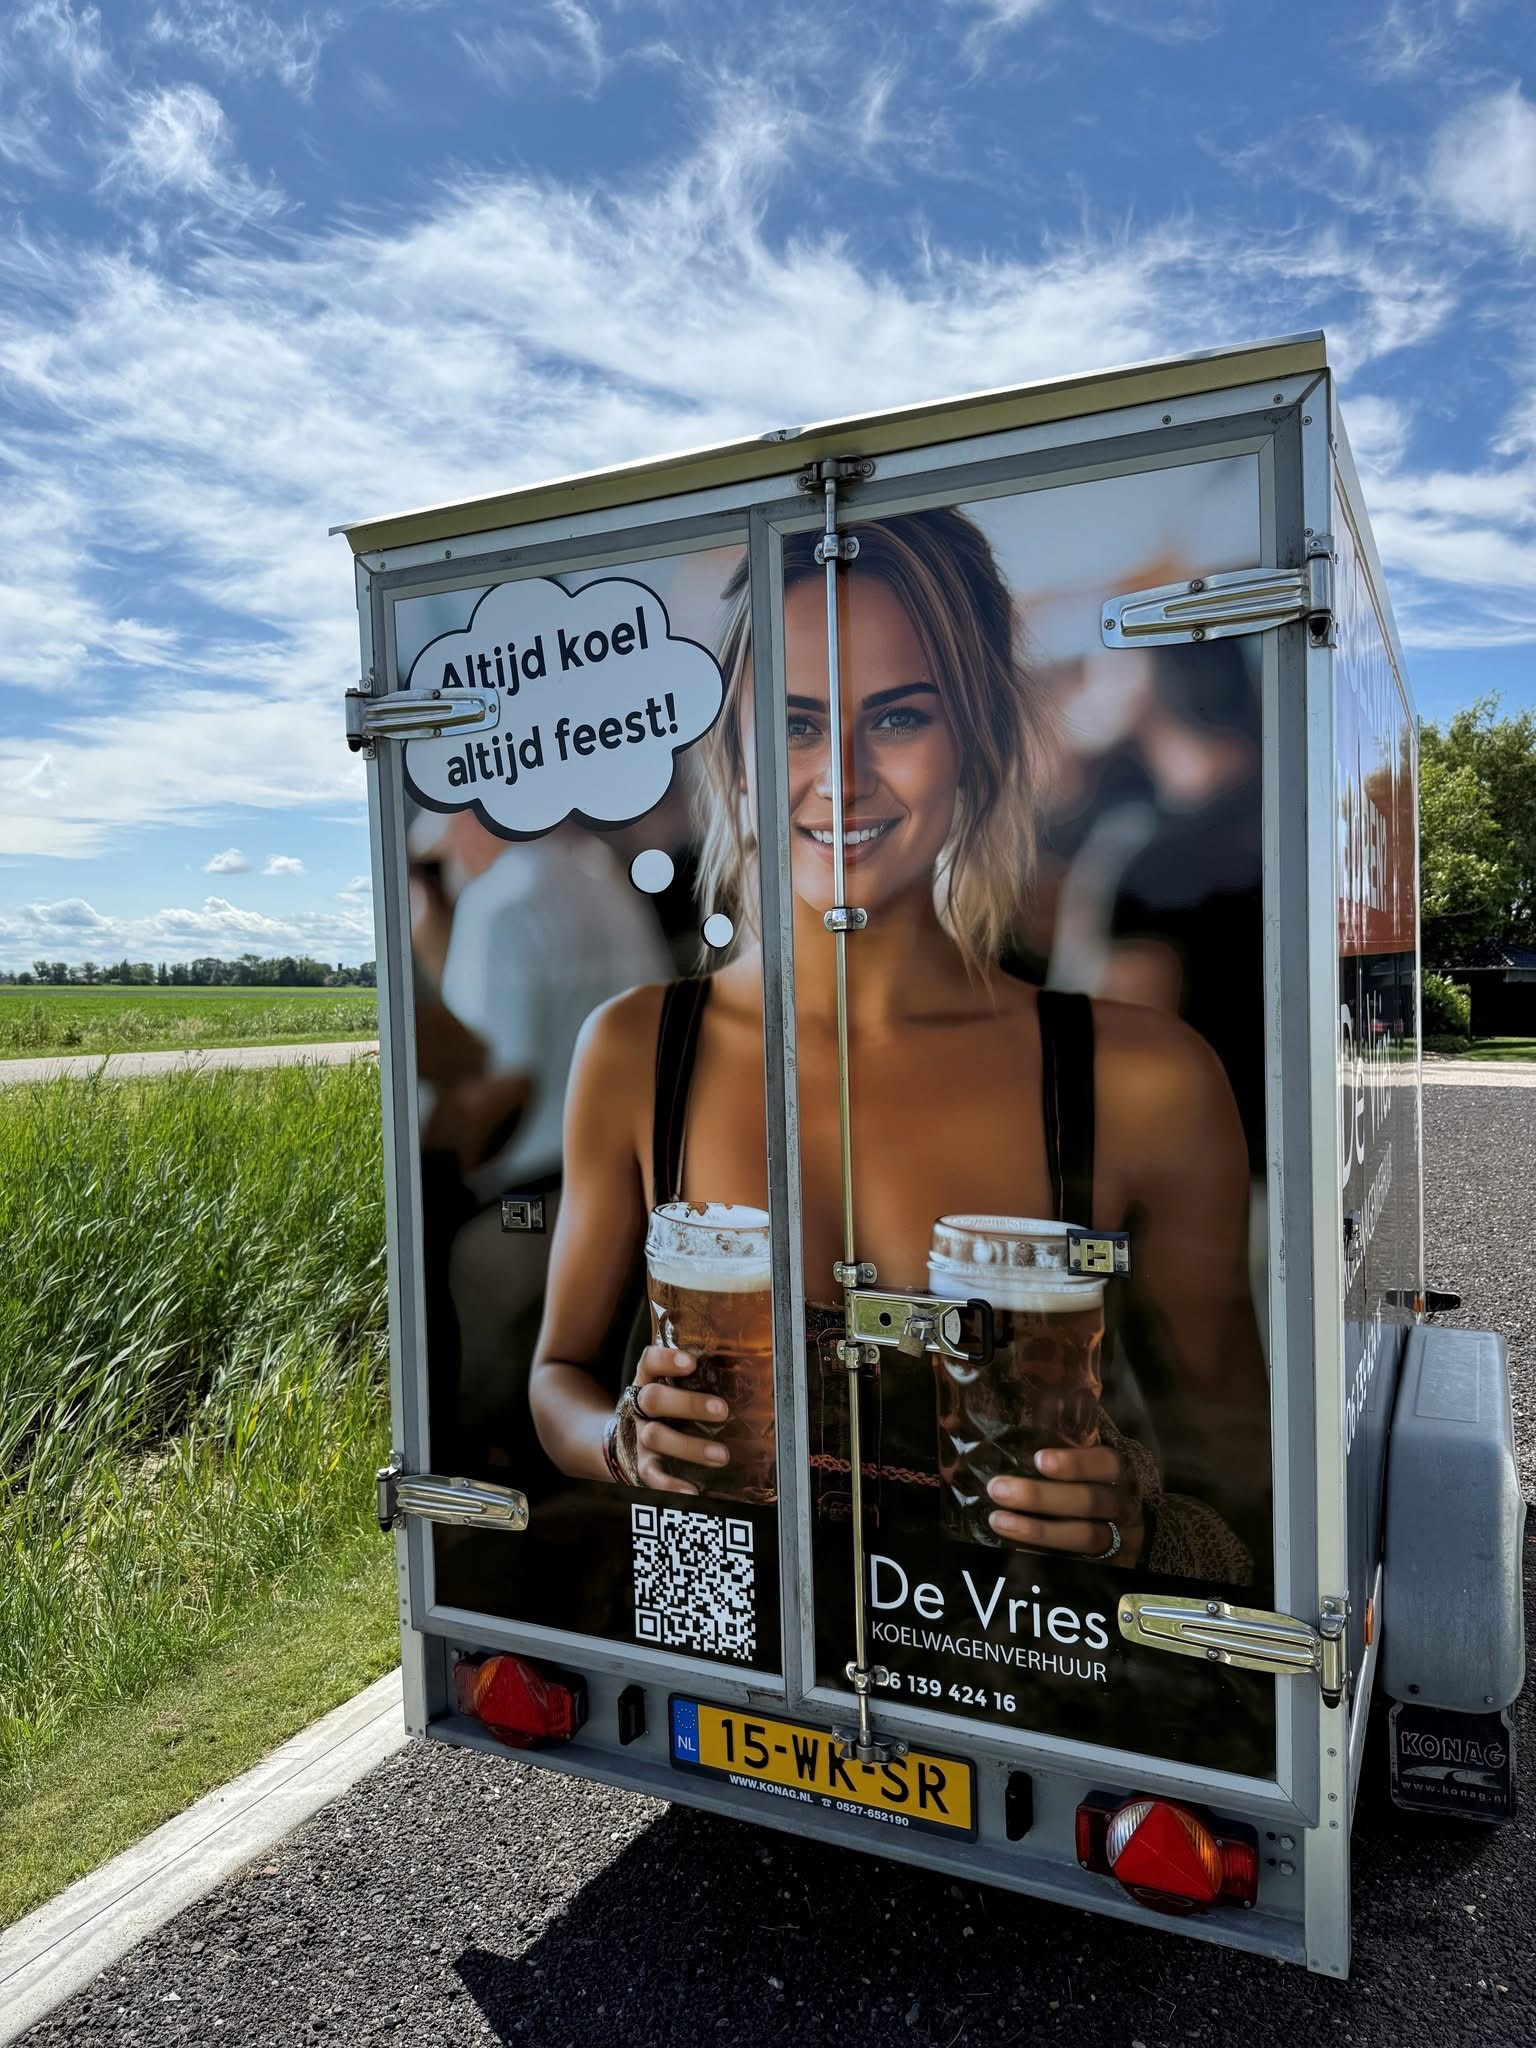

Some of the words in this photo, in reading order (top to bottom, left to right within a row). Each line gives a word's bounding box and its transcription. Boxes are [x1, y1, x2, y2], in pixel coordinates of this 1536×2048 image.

[441, 635, 546, 696] Altijd
[557, 606, 649, 671] koel
[446, 726, 545, 788] altijd
[554, 693, 679, 762] feest!
[870, 1553, 945, 1620] De
[961, 1569, 1109, 1650] Vries
[871, 1620, 1108, 1683] KOELWAGENVERHUUR
[907, 1674, 942, 1698] 139
[948, 1683, 988, 1708] 424
[993, 1691, 1017, 1713] 16
[677, 1735, 696, 1752] NL
[721, 1718, 950, 1815] 15-WK-SR
[1400, 1731, 1506, 1769] KONAG
[729, 1774, 814, 1804] WWW.KONAG.NL
[836, 1801, 910, 1828] 0527-652190
[1401, 1780, 1507, 1804] www.konag.nl
